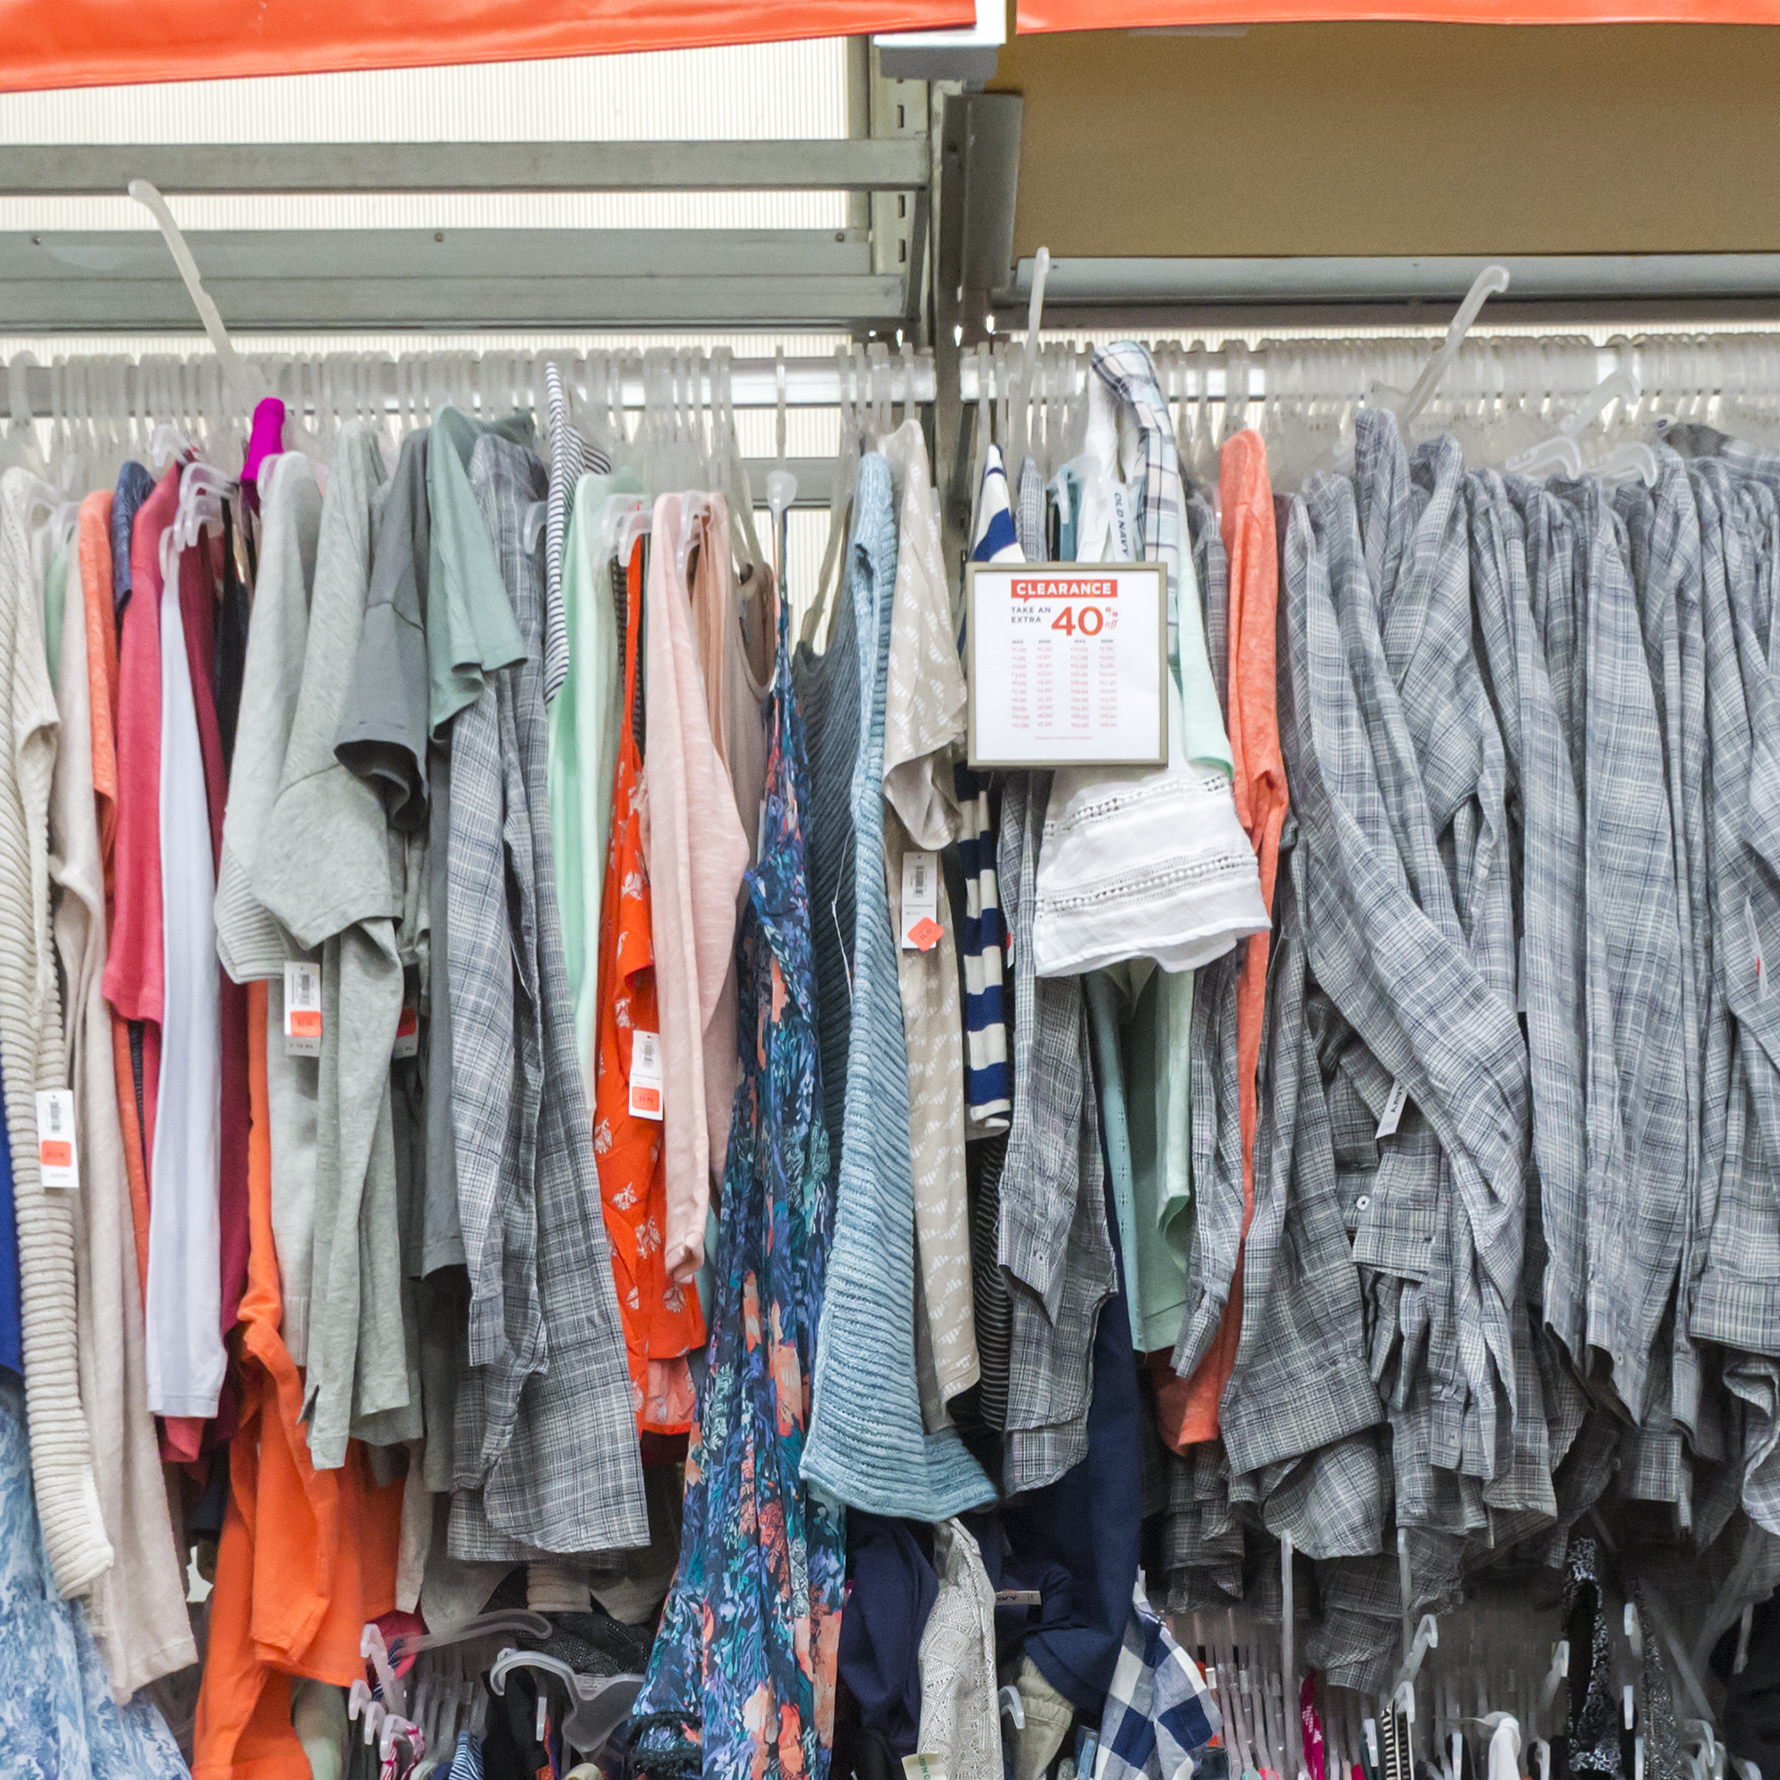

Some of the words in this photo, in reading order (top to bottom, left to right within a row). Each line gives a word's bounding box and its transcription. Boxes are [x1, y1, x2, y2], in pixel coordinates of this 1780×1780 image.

[1114, 492, 1124, 518] OLD
[1117, 520, 1129, 557] NAVY
[1016, 582, 1112, 596] CLEARANCE
[1011, 606, 1035, 614] TAKE
[1038, 606, 1051, 614] AN
[1011, 616, 1042, 624] EXTRA
